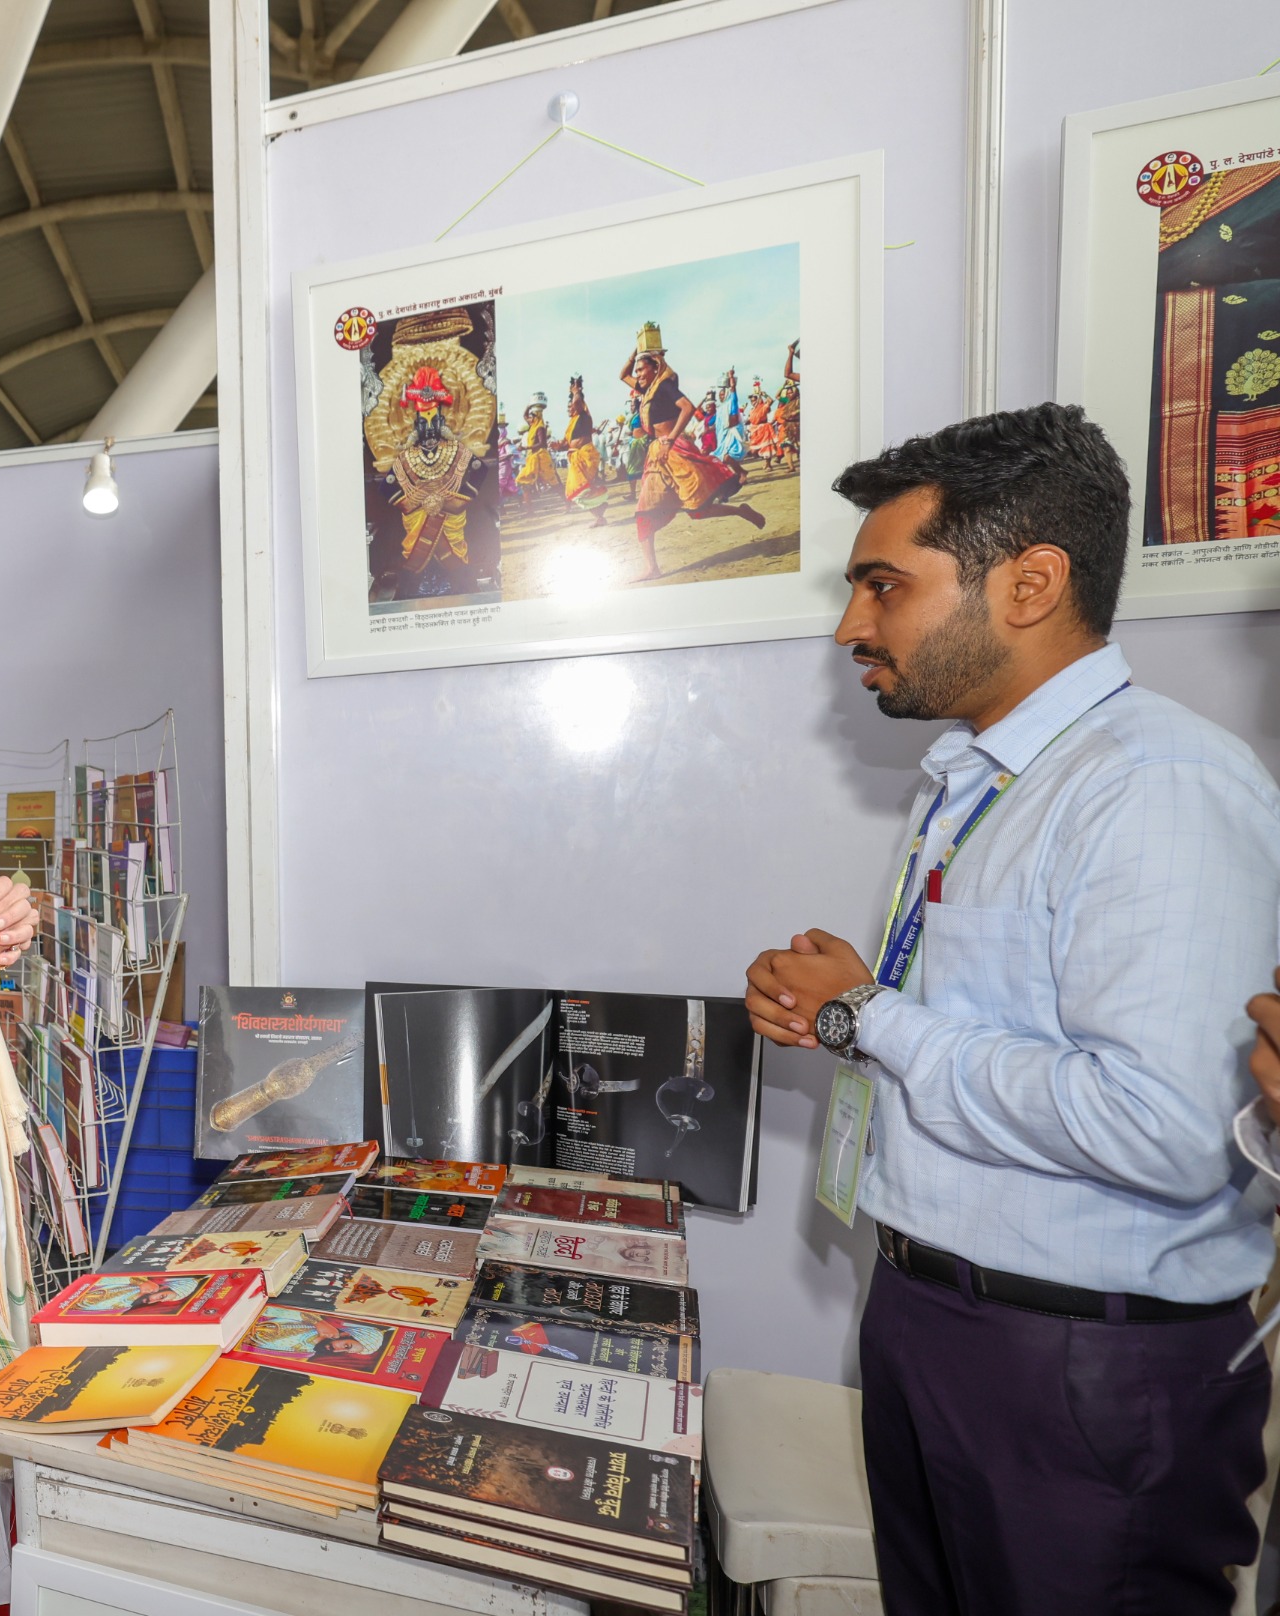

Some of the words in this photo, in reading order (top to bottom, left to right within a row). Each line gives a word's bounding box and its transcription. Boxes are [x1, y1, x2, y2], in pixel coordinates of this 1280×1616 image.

[1210, 159, 1220, 170] पु.
[1223, 156, 1235, 166] ल.
[1237, 147, 1275, 164] देशपांडे
[419, 299, 441, 310] महाराष्ट्र
[442, 297, 457, 305] कला
[1141, 560, 1160, 568] मकर
[1223, 552, 1233, 561] की
[1142, 552, 1160, 560] मकर
[1233, 543, 1252, 552] आणि
[889, 951, 910, 981] महाराष्ट्र
[902, 925, 918, 950] शासन
[599, 1379, 618, 1394] हिन्दी
[553, 1391, 571, 1414] उपन्यास
[574, 1383, 592, 1417] उपन्यासकार
[598, 1395, 616, 1403] के
[594, 1403, 614, 1429] प्रतिनिधि
[608, 1452, 627, 1474] प्रथम
[603, 1474, 631, 1499] विश्व
[594, 1498, 621, 1519] युद्ध
